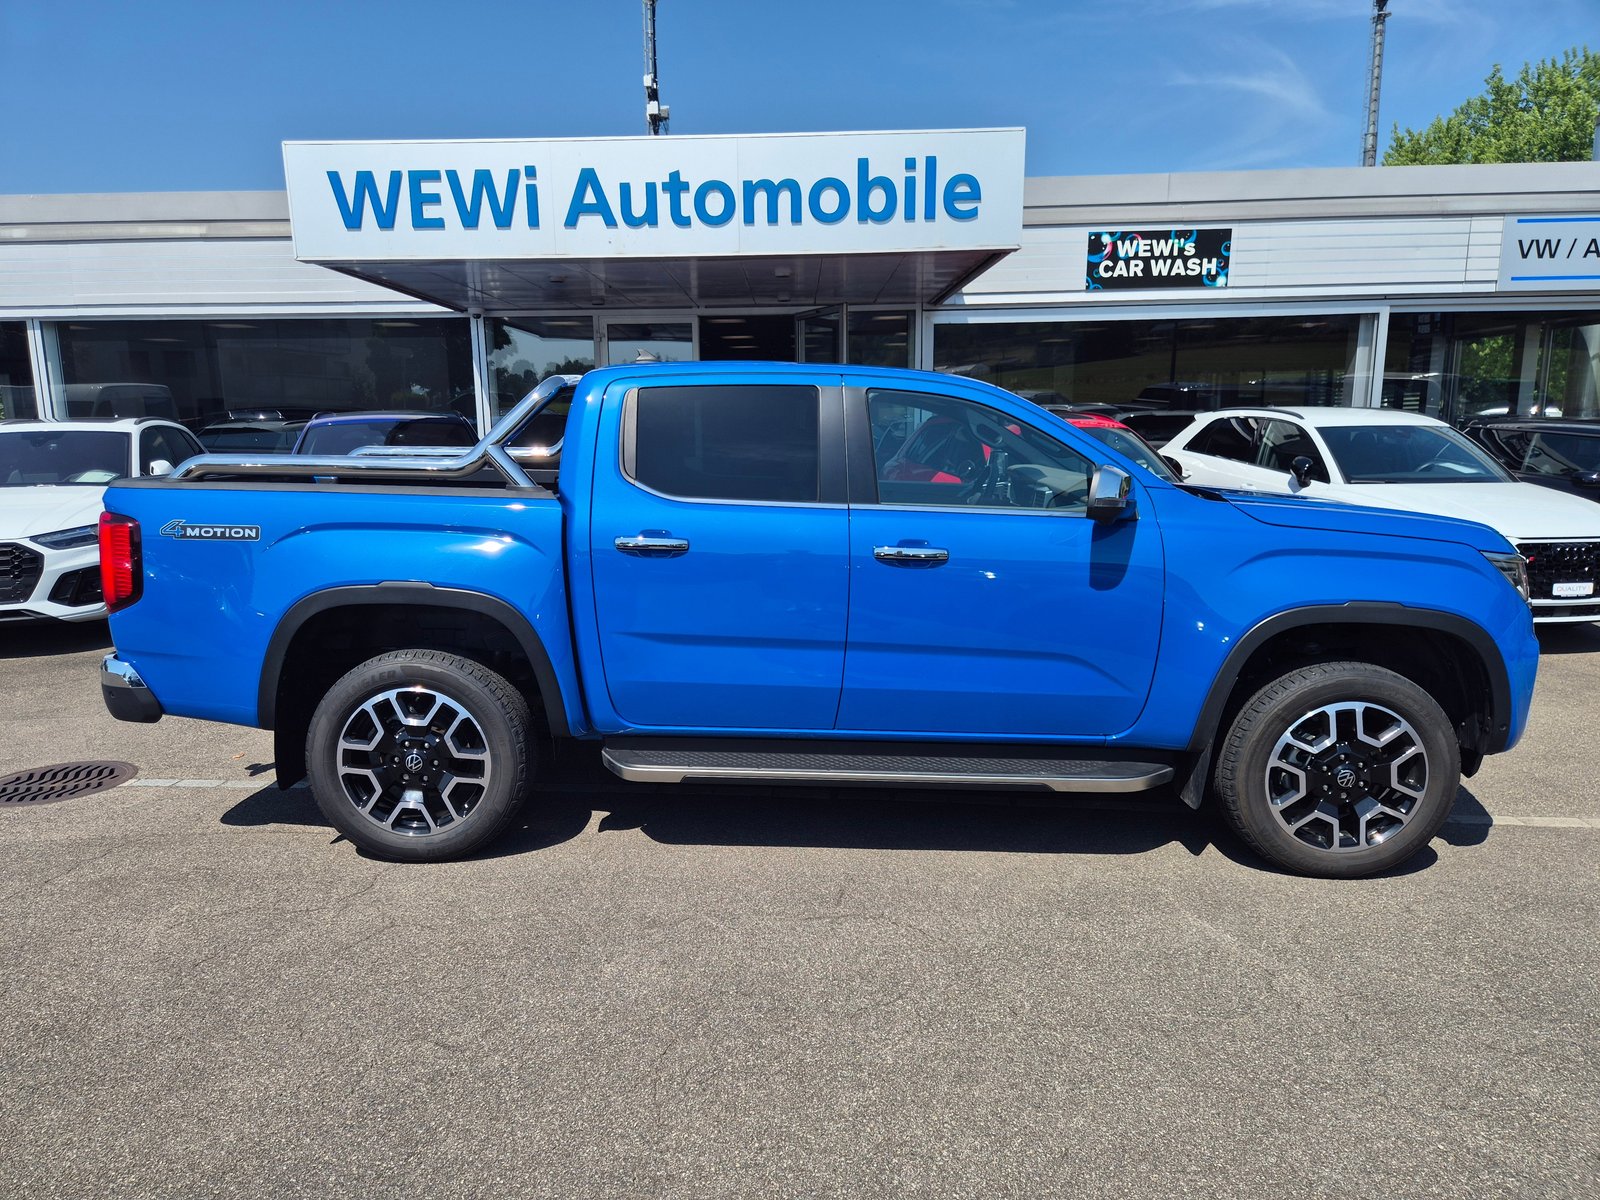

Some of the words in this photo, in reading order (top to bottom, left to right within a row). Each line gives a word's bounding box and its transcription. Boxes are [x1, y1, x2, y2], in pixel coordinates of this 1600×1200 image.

[326, 165, 540, 231] WEWi
[563, 156, 982, 230] Automobile
[1117, 237, 1196, 258] WEWi's
[1517, 238, 1562, 260] VW
[1099, 259, 1144, 278] CAR
[1150, 257, 1217, 277] WASH
